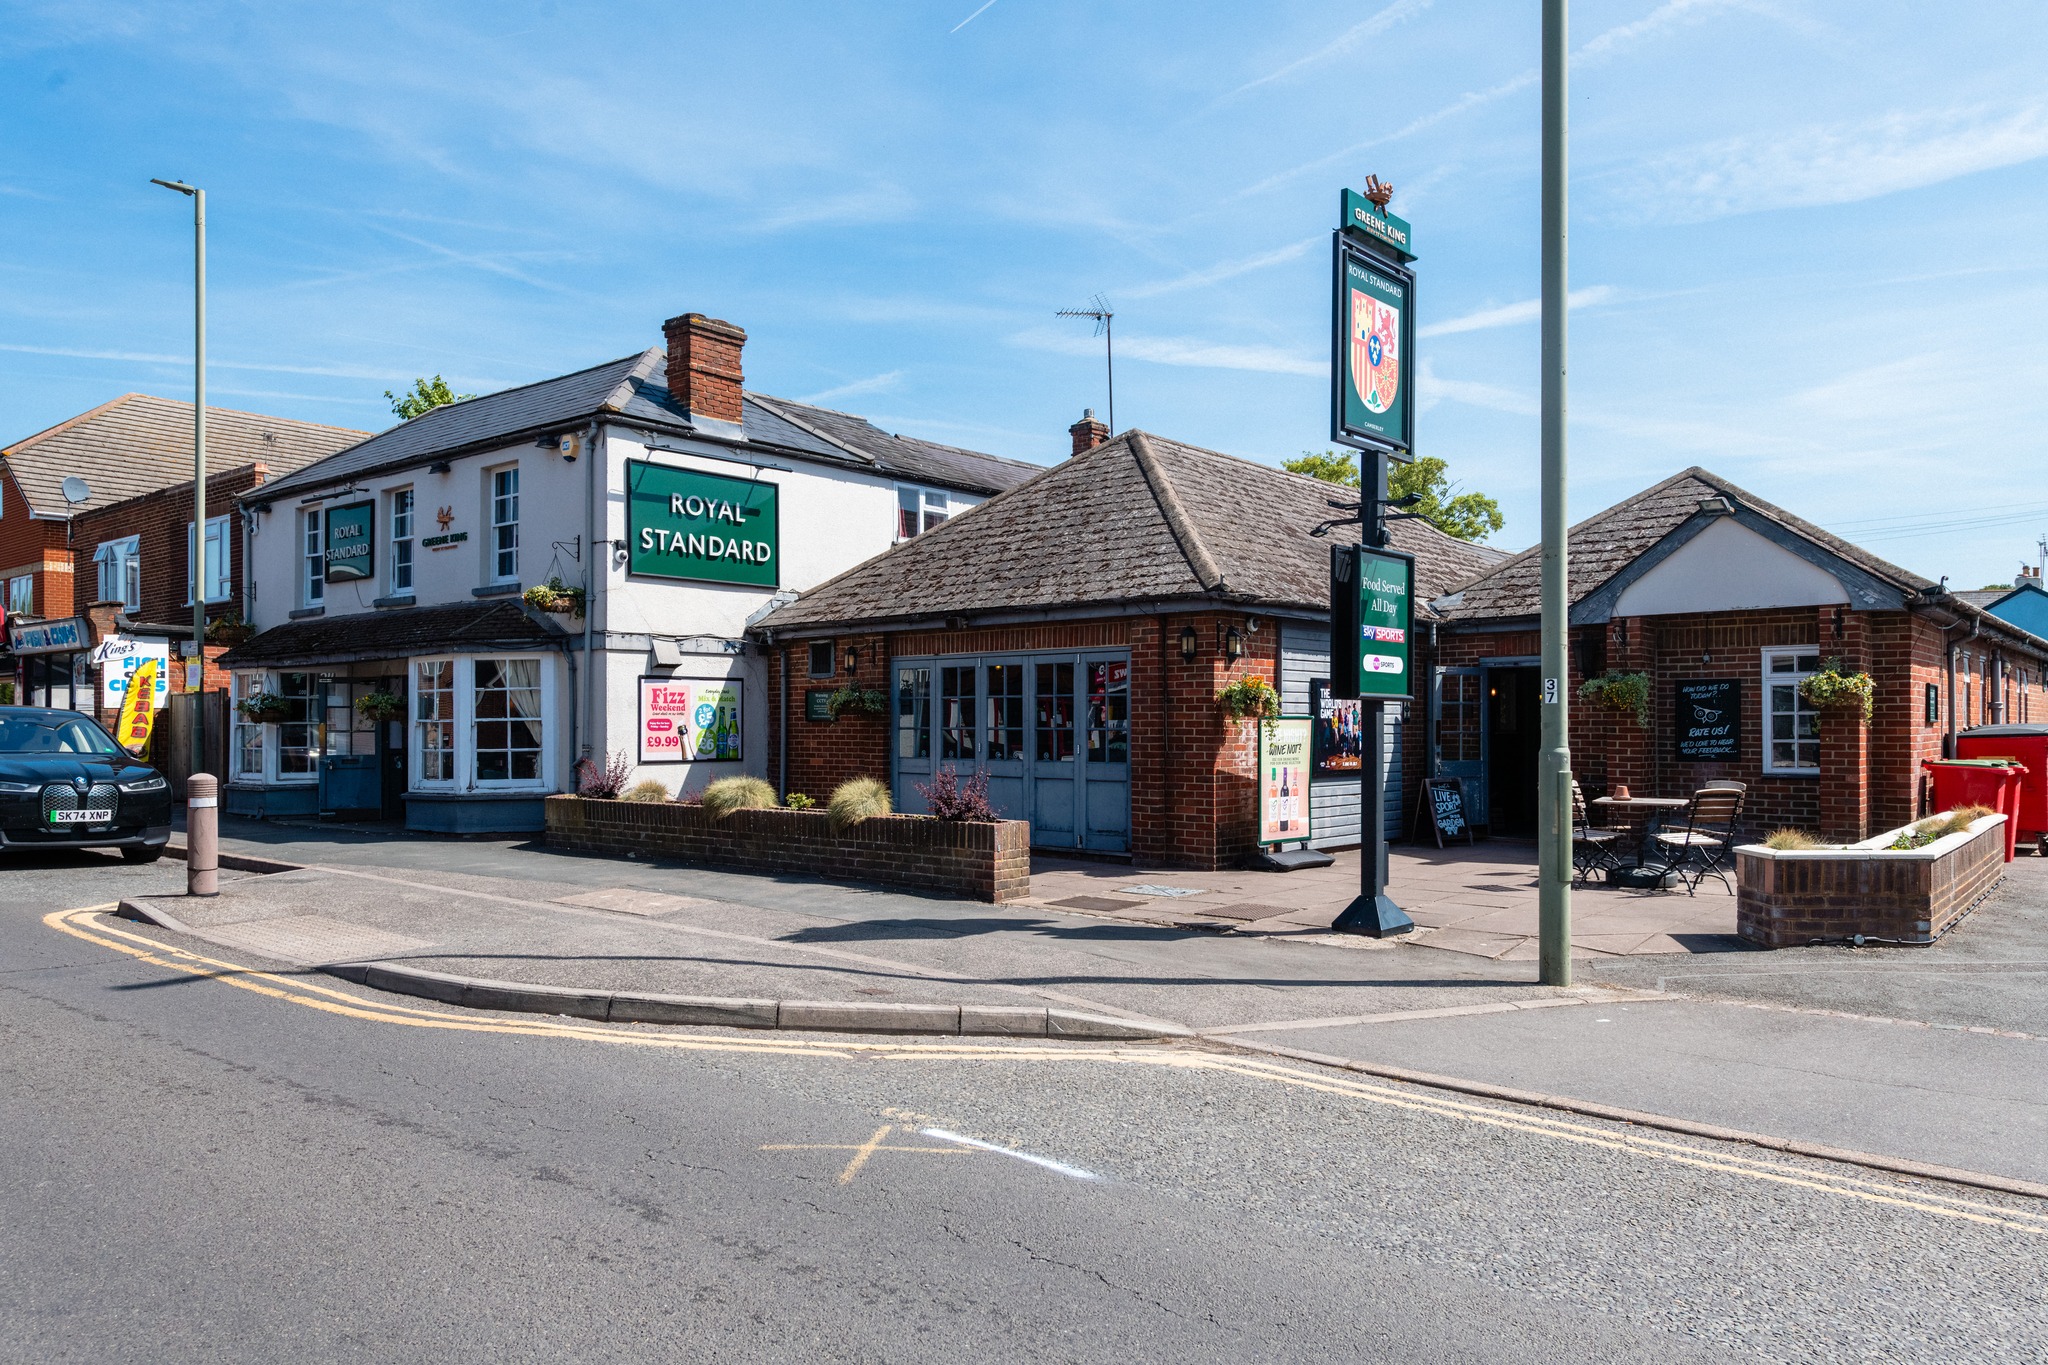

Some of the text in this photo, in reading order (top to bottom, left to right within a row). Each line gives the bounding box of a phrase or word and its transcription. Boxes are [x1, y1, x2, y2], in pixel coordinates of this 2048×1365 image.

[1355, 208, 1385, 232] GREENE
[1387, 224, 1406, 244] KING
[1348, 265, 1402, 298] ROYAL STANDARD
[670, 492, 746, 523] ROYAL
[334, 524, 360, 539] ROYAL
[422, 532, 468, 547] GREENE KING
[641, 527, 771, 562] STANDARD
[326, 543, 369, 561] STANDARD
[1362, 577, 1405, 595] Food Served
[1371, 598, 1397, 617] All Day
[1363, 626, 1404, 642] sky SPORTS
[97, 641, 136, 660] King's
[1380, 661, 1395, 669] SPORTS
[651, 687, 685, 704] Fizz
[1320, 688, 1331, 699] THE
[130, 674, 152, 738] KEBAB
[650, 704, 686, 712] Weekend
[1320, 698, 1342, 709] WORLD'S
[1320, 708, 1334, 719] GAME
[1688, 724, 1730, 737] RATE US!
[647, 736, 679, 747] £9.99
[1269, 743, 1302, 756] WINE NOT?
[1434, 790, 1450, 802] LIVE
[58, 811, 109, 820] SK74 XNP
